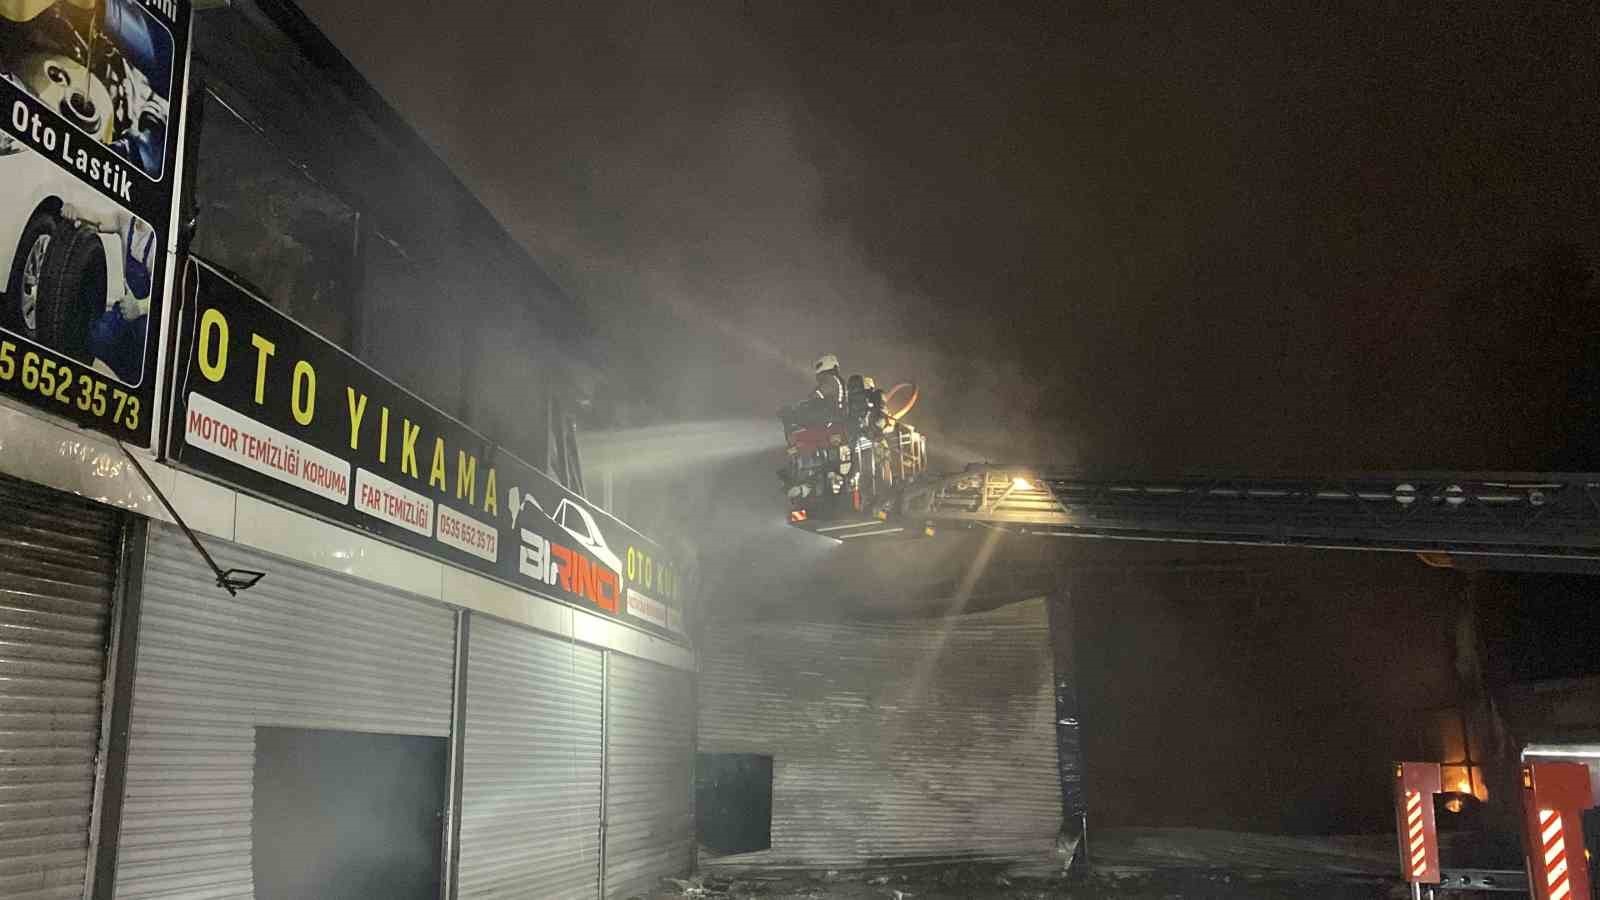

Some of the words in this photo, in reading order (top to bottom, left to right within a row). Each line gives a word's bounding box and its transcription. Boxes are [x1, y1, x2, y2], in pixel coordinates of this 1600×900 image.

[12, 100, 57, 151] Oto
[62, 132, 134, 202] Lastik
[21, 352, 73, 404] 652
[77, 375, 108, 417] 35
[113, 389, 140, 430] 73
[198, 308, 316, 426] OTO
[347, 386, 497, 517] YIKAMA
[188, 410, 238, 450] MOTOR
[241, 432, 300, 476] TEMİZLİĞİ
[302, 458, 347, 496] KORUMA
[361, 484, 380, 510] FAR
[383, 494, 429, 530] TEMİZLİĞİ
[440, 513, 460, 539] 0535
[461, 523, 476, 546] 652
[626, 545, 652, 591] OTO
